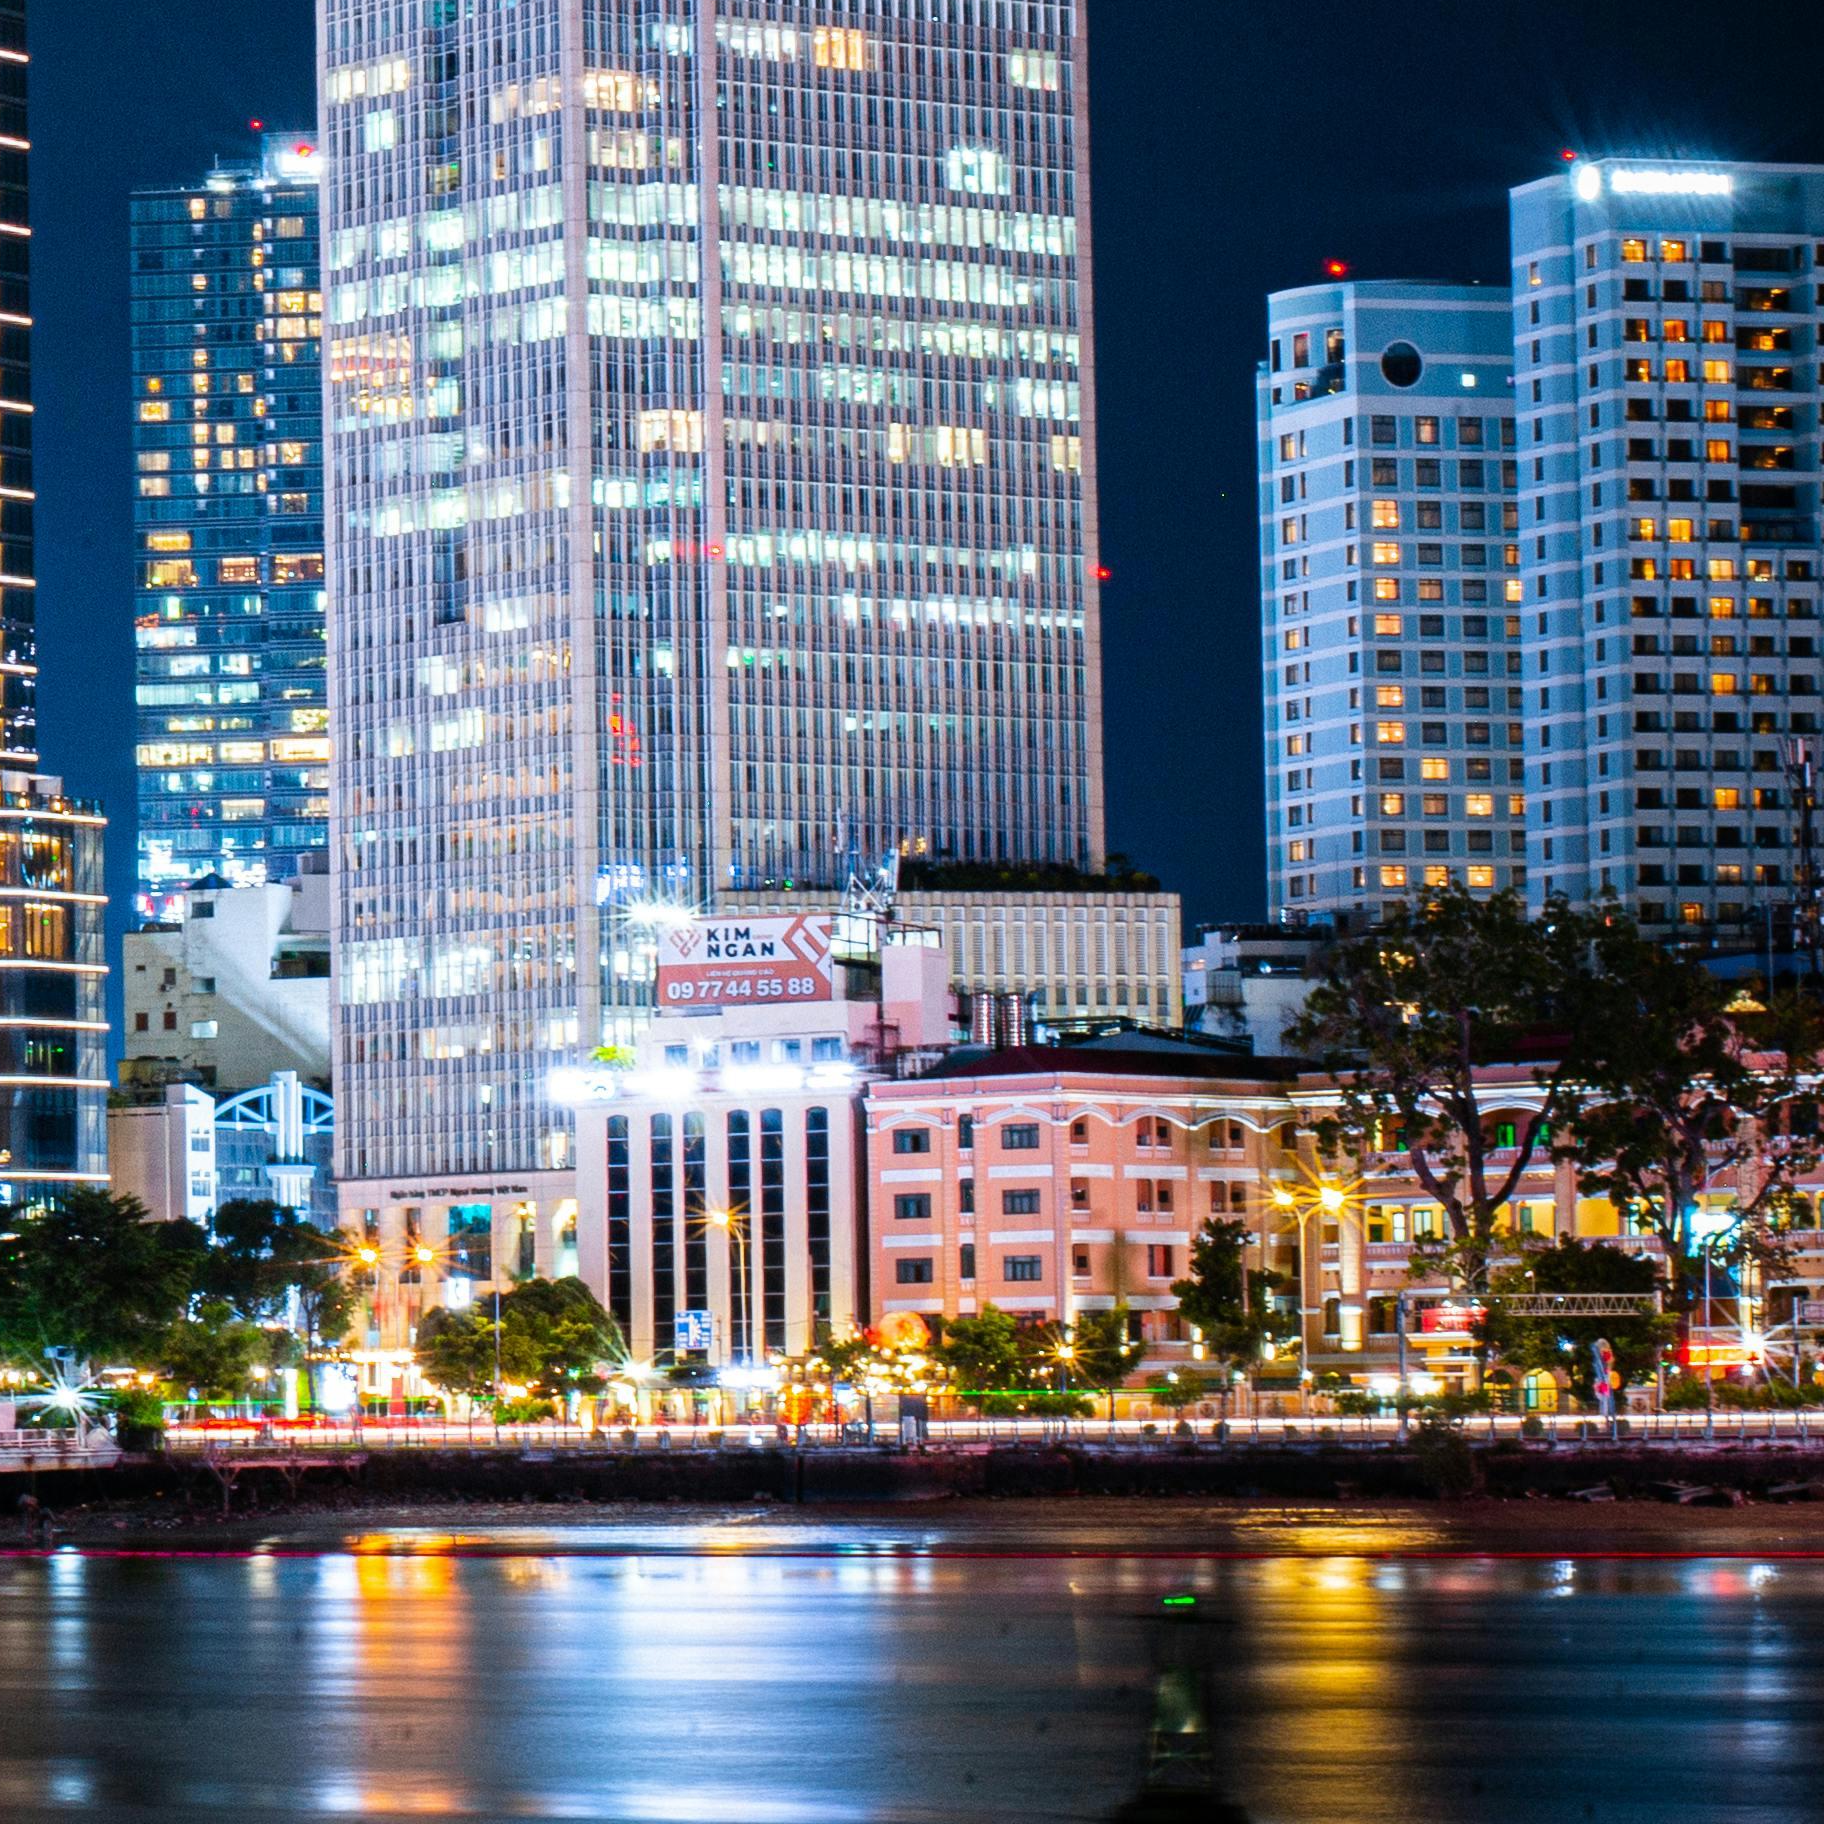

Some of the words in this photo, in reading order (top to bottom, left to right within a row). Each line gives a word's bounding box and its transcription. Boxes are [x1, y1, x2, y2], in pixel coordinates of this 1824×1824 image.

[707, 927, 751, 941] KIM
[707, 942, 774, 958] NGAN
[667, 982, 694, 1000] 09
[698, 981, 723, 998] 77
[726, 980, 752, 997] 44
[757, 979, 783, 996] 55
[788, 977, 815, 995] 88
